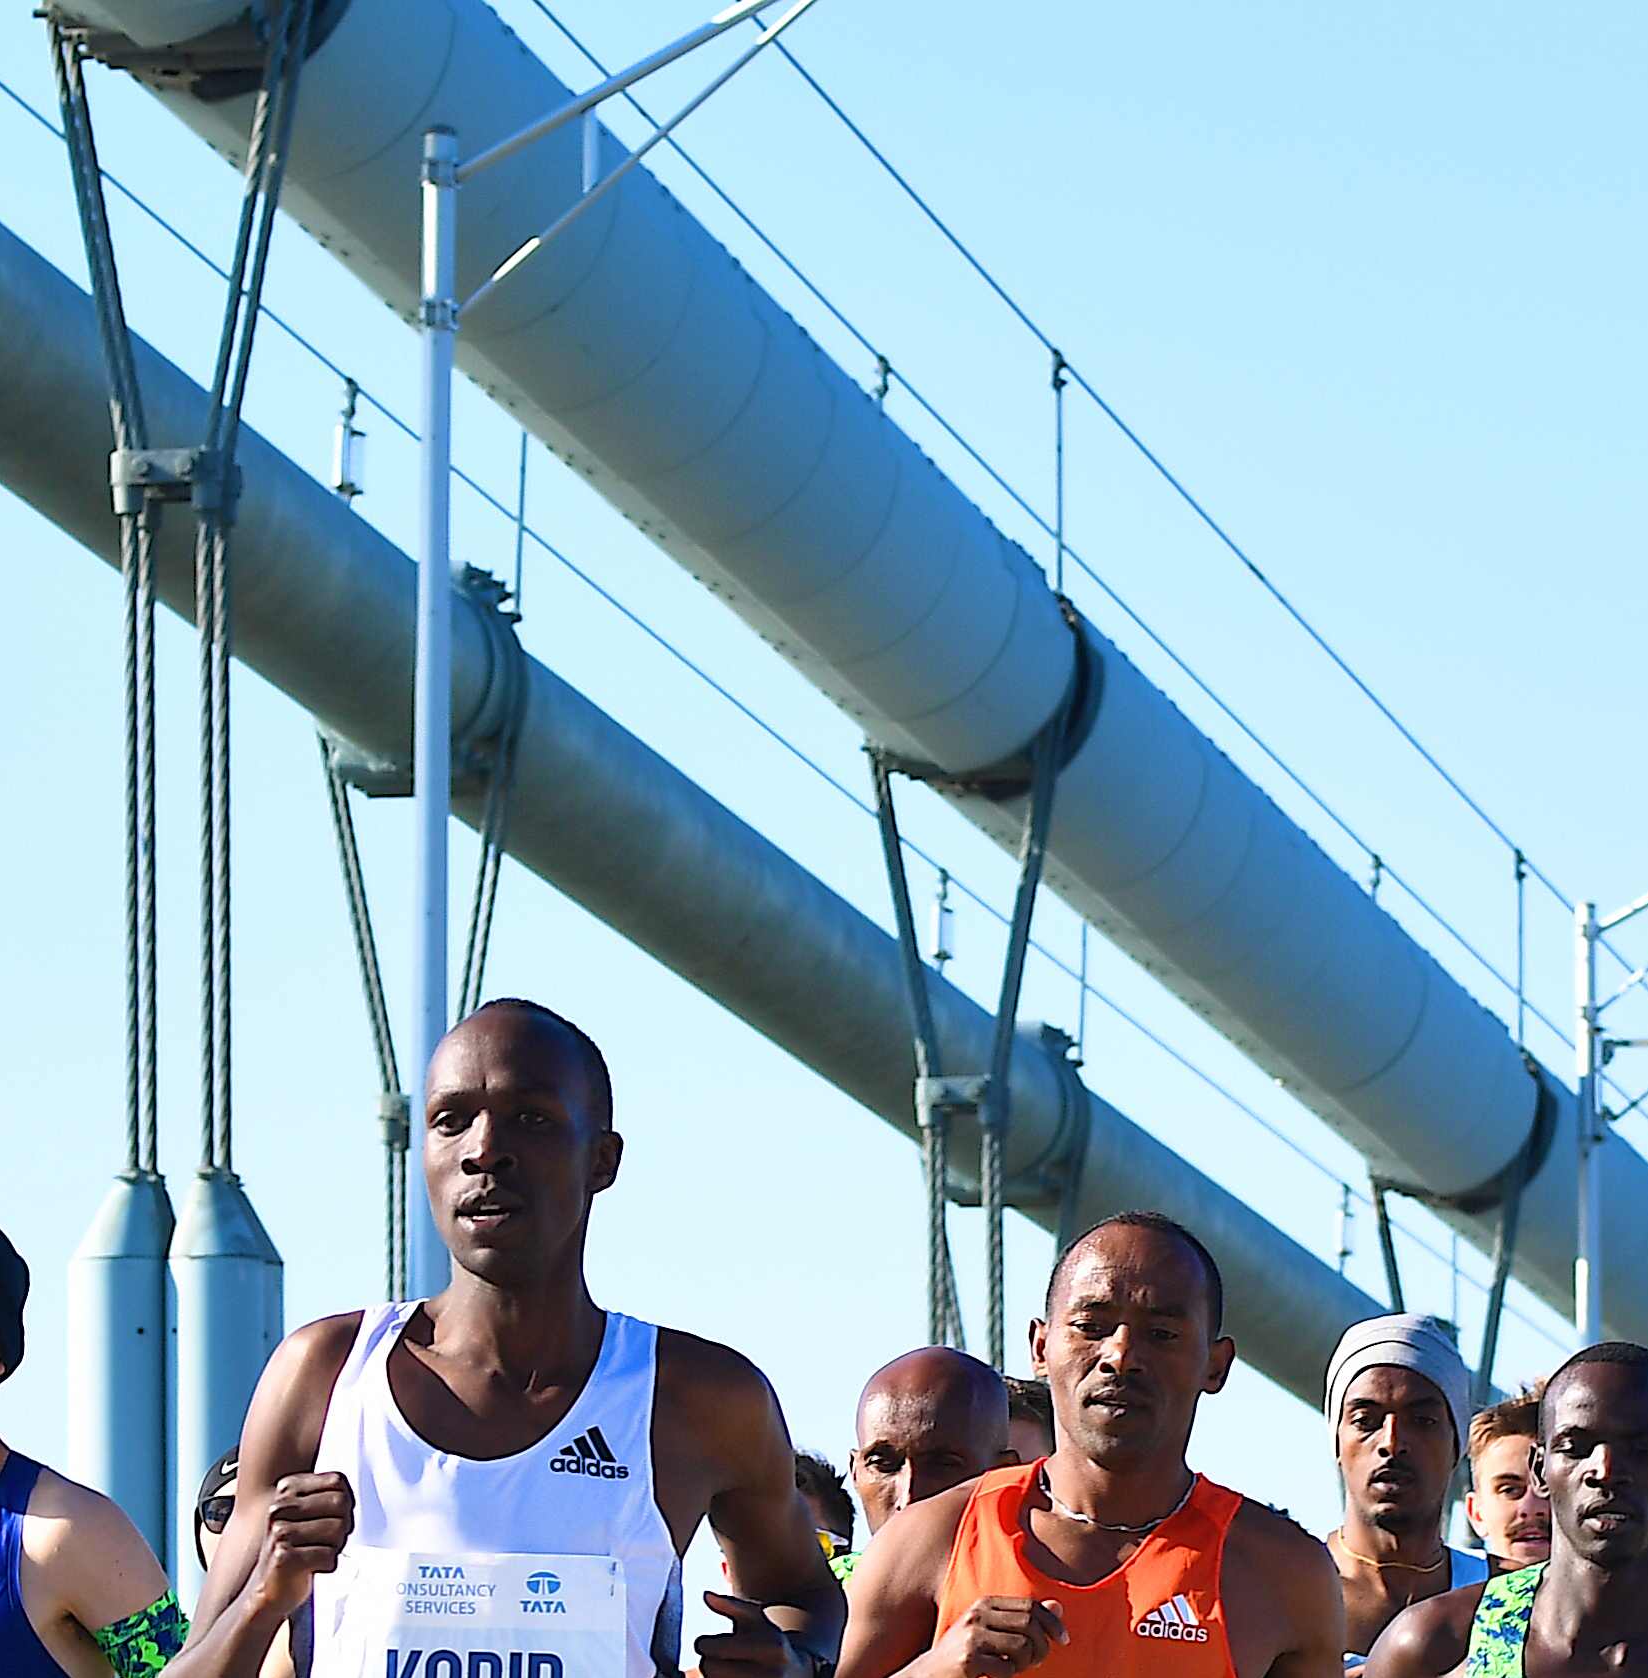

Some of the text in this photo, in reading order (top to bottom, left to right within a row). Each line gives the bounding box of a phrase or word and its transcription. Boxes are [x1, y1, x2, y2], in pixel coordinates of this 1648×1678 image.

[550, 1455, 629, 1479] adidas
[418, 1566, 465, 1579] TATA
[396, 1582, 496, 1598] ONSULTANCY
[406, 1601, 476, 1615] SERVICES
[520, 1600, 567, 1614] TATA
[1136, 1621, 1208, 1642] adidas
